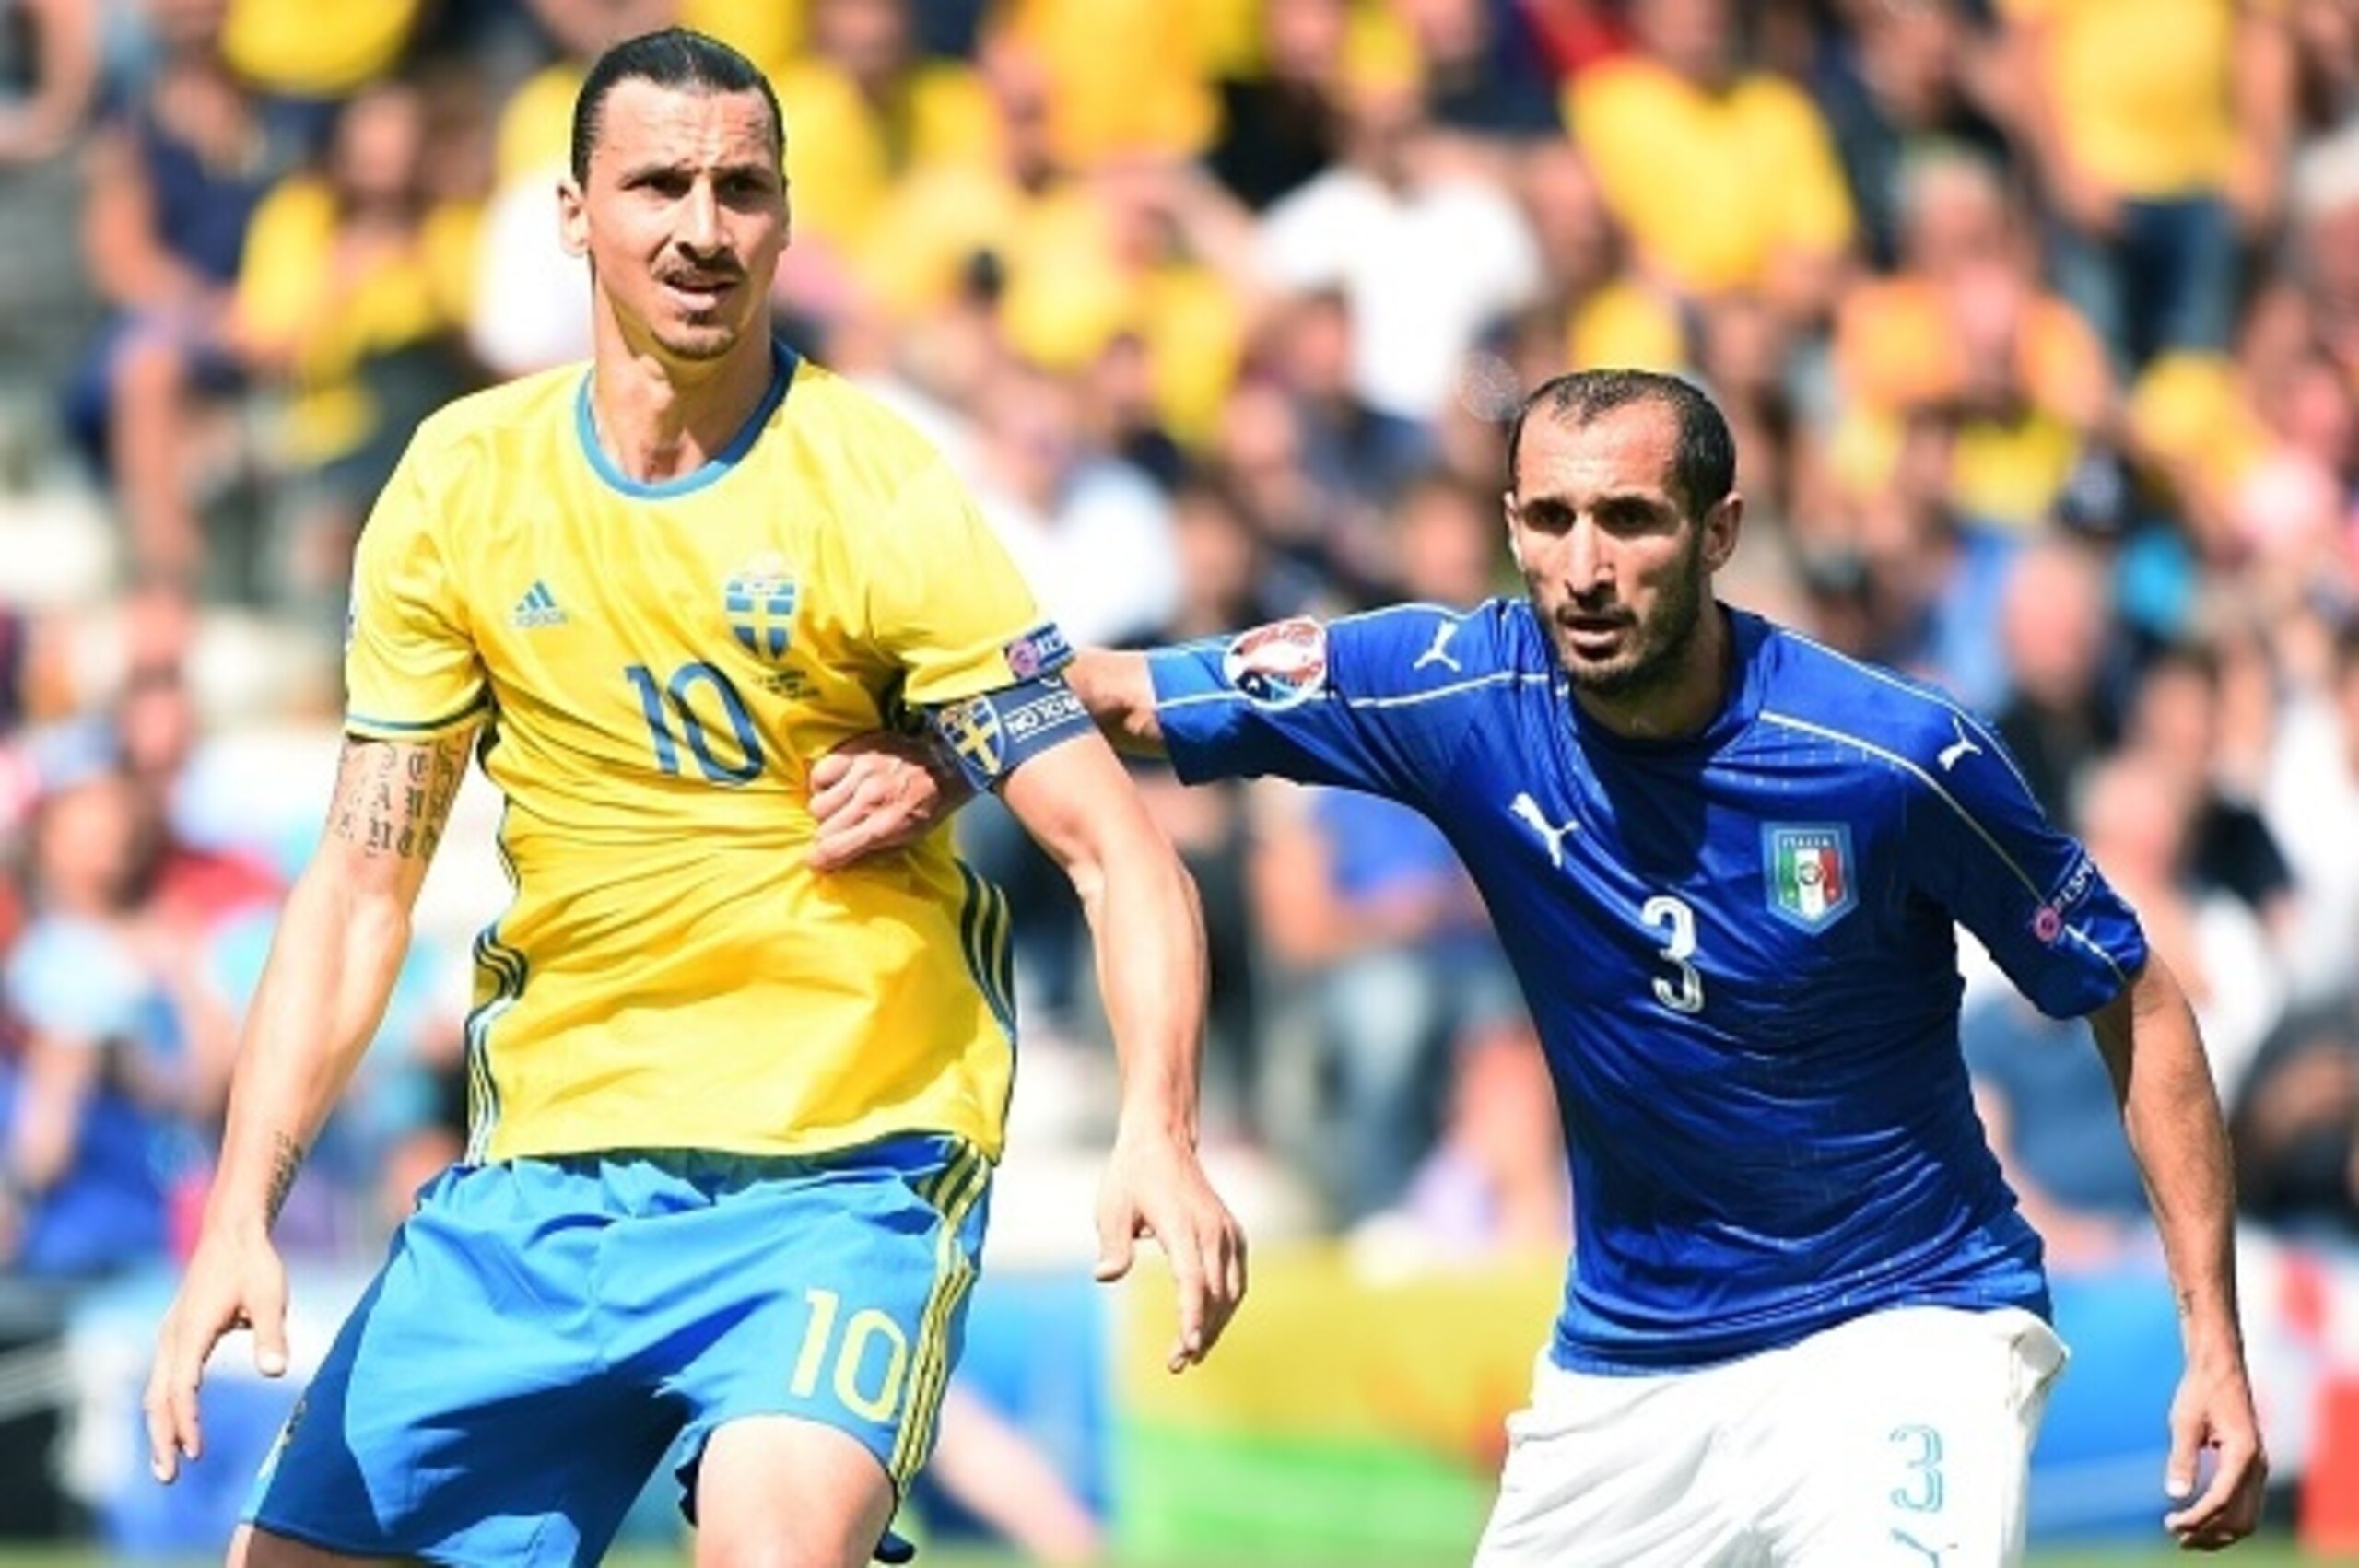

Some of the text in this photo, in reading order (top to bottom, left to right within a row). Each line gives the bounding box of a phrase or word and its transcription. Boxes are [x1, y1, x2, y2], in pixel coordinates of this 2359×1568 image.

[624, 661, 765, 785] 10
[1782, 837, 1832, 848] ITALIA
[1640, 895, 1703, 1012] 3
[790, 1287, 908, 1422] 10
[1889, 1424, 1943, 1513] 3
